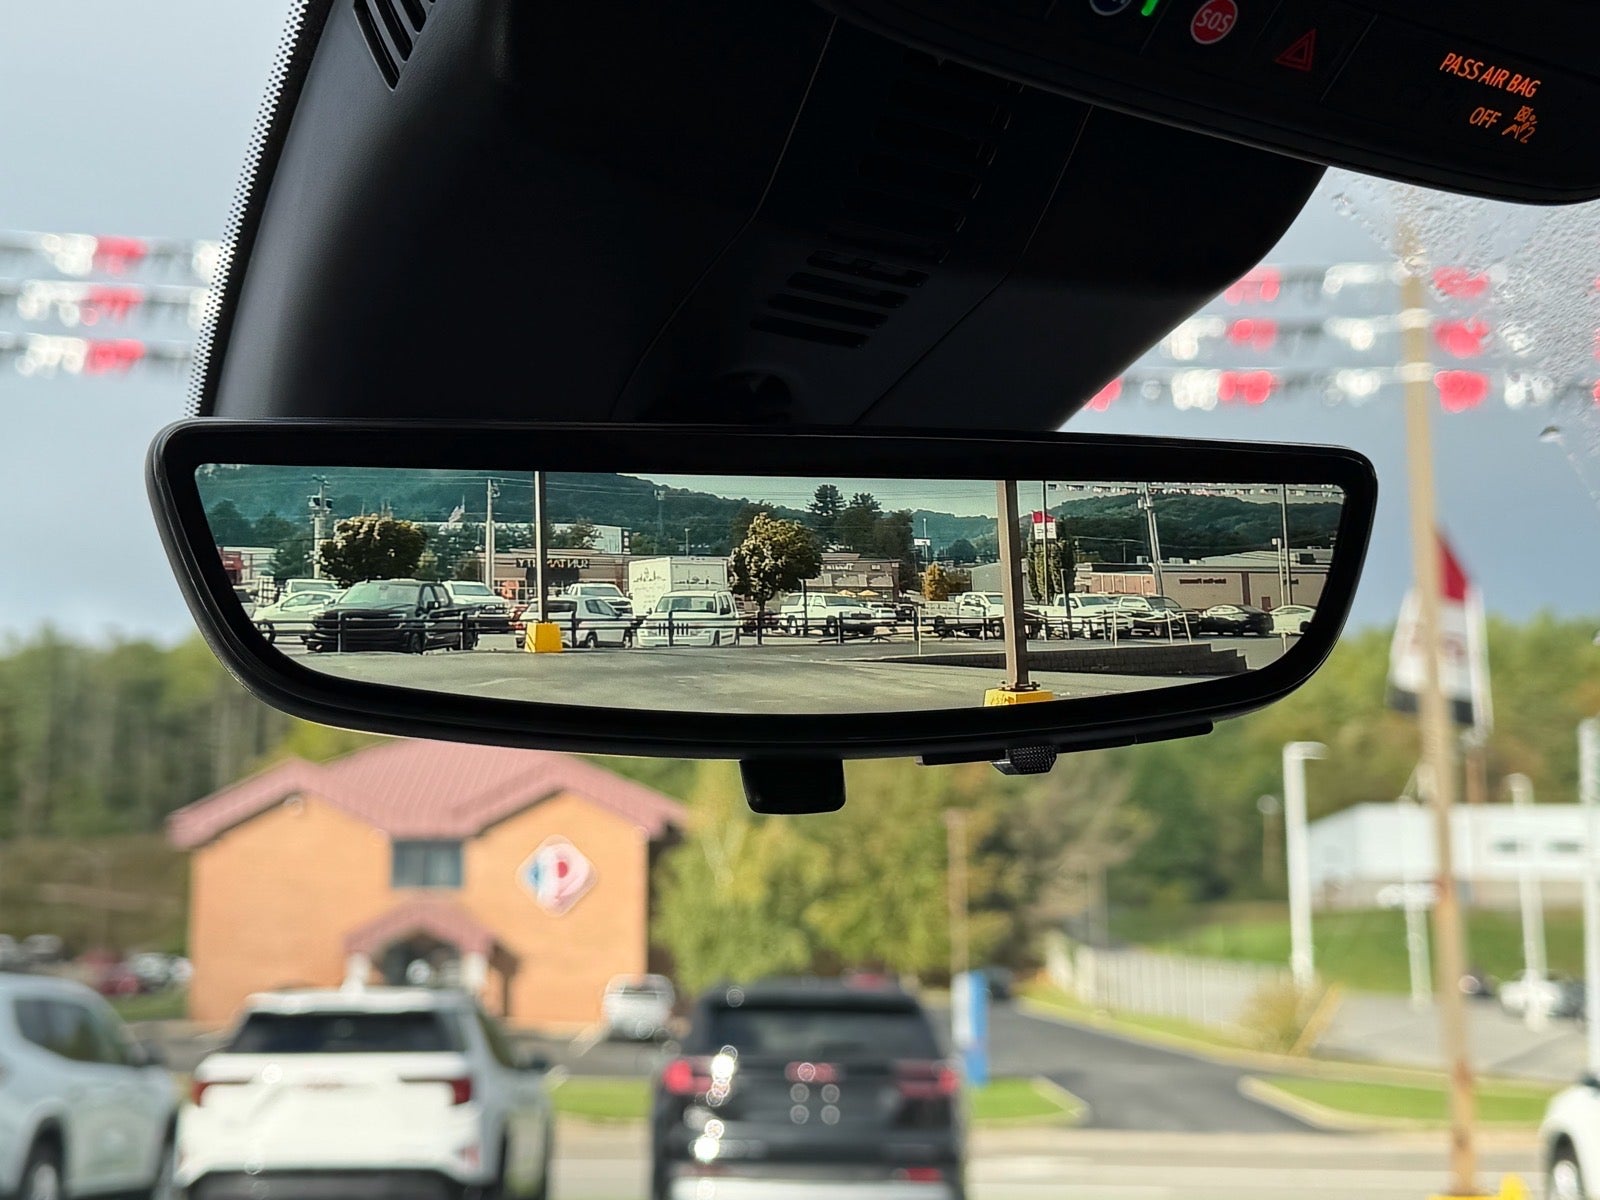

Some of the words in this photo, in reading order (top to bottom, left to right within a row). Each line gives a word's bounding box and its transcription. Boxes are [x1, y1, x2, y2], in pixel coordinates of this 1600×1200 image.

[1195, 9, 1233, 33] SOS
[1439, 52, 1485, 80] PASS
[1477, 66, 1510, 89] AIR
[1505, 73, 1541, 97] BAG
[1469, 106, 1502, 128] OFF
